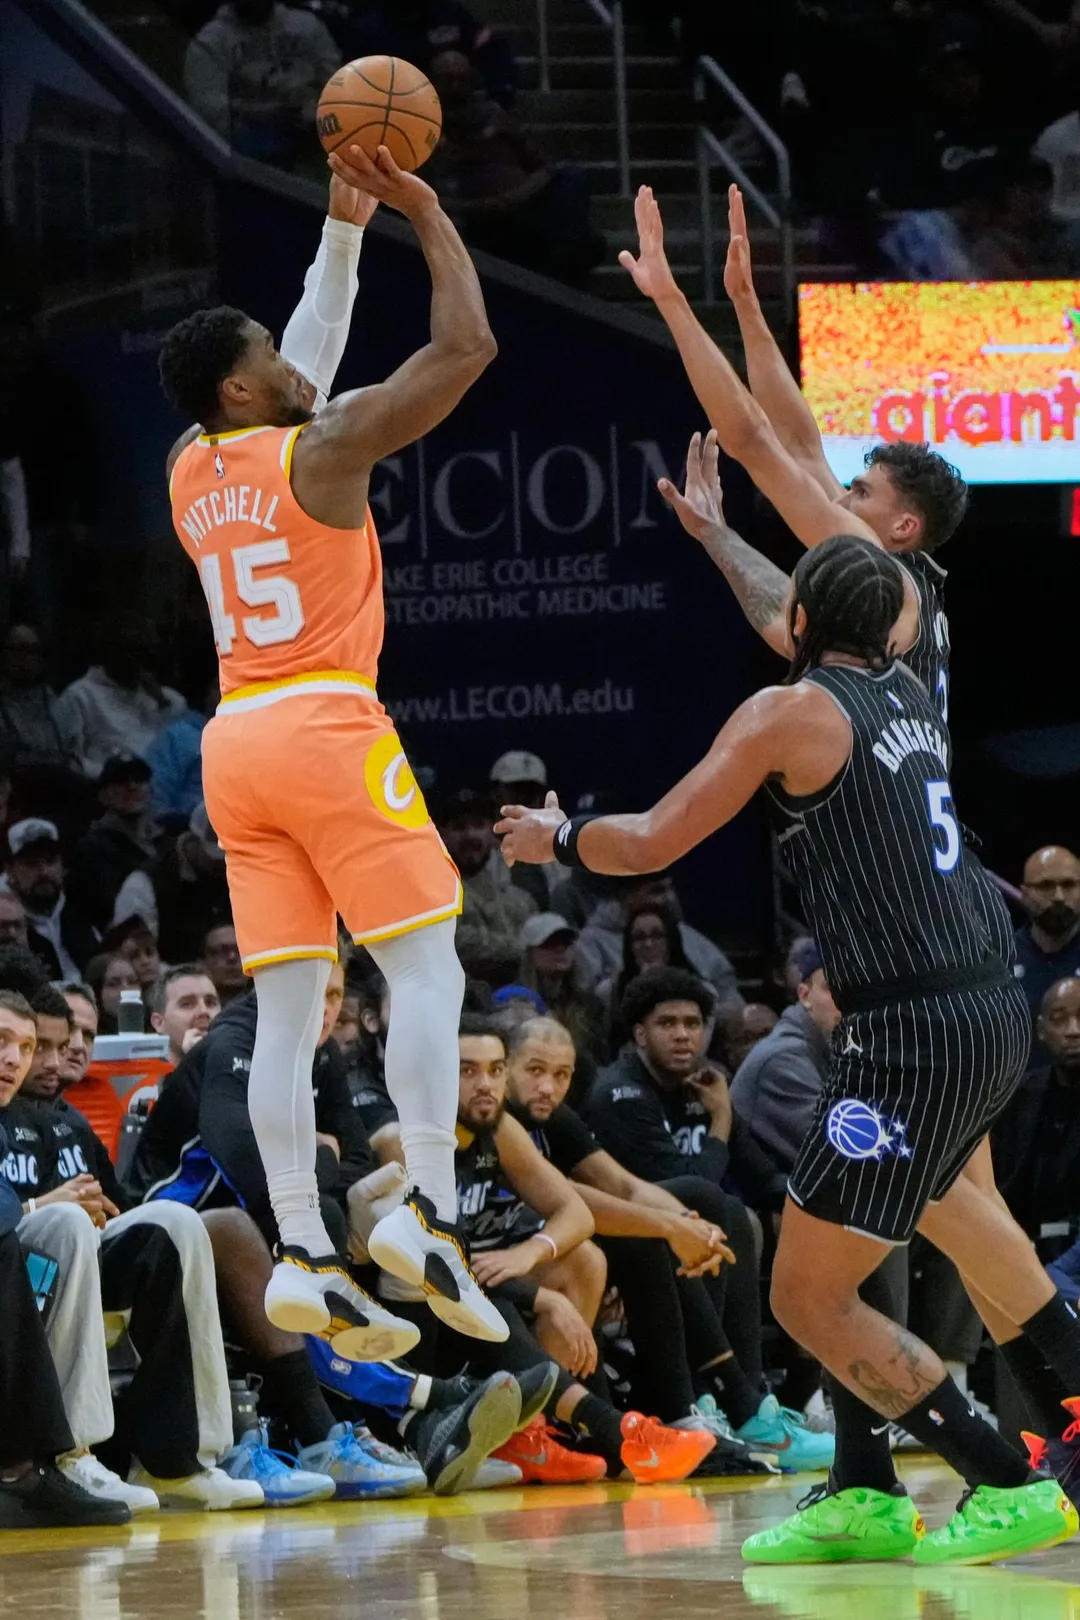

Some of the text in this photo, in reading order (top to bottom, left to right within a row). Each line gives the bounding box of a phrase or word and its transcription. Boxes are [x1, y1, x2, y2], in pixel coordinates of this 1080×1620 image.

[180, 485, 280, 548] MITCHELL
[200, 537, 306, 657] 45
[432, 560, 488, 590] ERIE
[493, 552, 609, 586] COLLEGE
[385, 581, 666, 625] TEOPATHIC MEDICINE
[926, 779, 960, 873] 5
